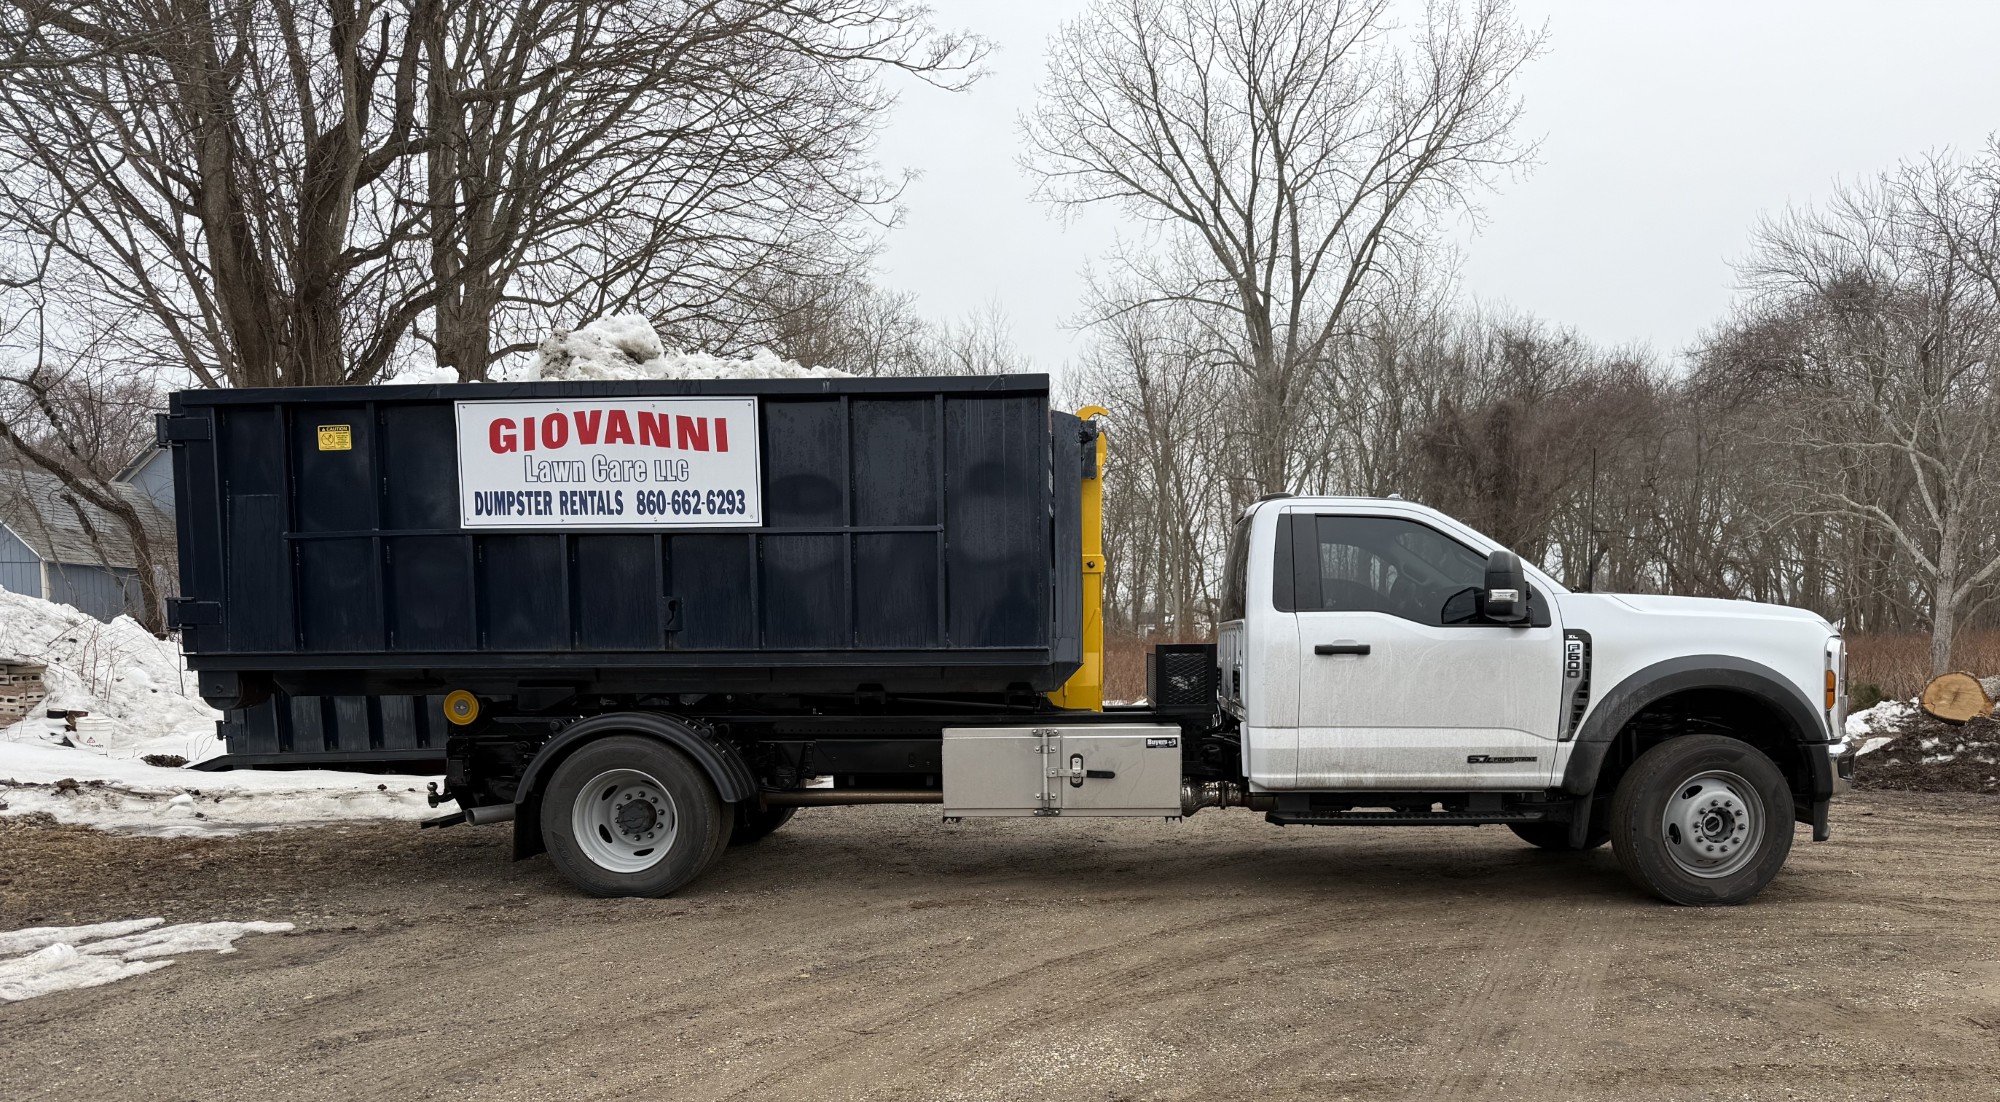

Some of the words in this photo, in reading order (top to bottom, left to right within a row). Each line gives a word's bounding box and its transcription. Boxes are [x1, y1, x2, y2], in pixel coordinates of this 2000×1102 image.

[489, 410, 728, 454] GIOVANNI
[524, 455, 586, 482] Lawn
[592, 454, 647, 482] Care
[654, 459, 689, 482] LLC
[475, 491, 553, 516] DUMPSTER
[560, 490, 624, 515] RENTALS
[637, 489, 746, 515] 860-662-6293
